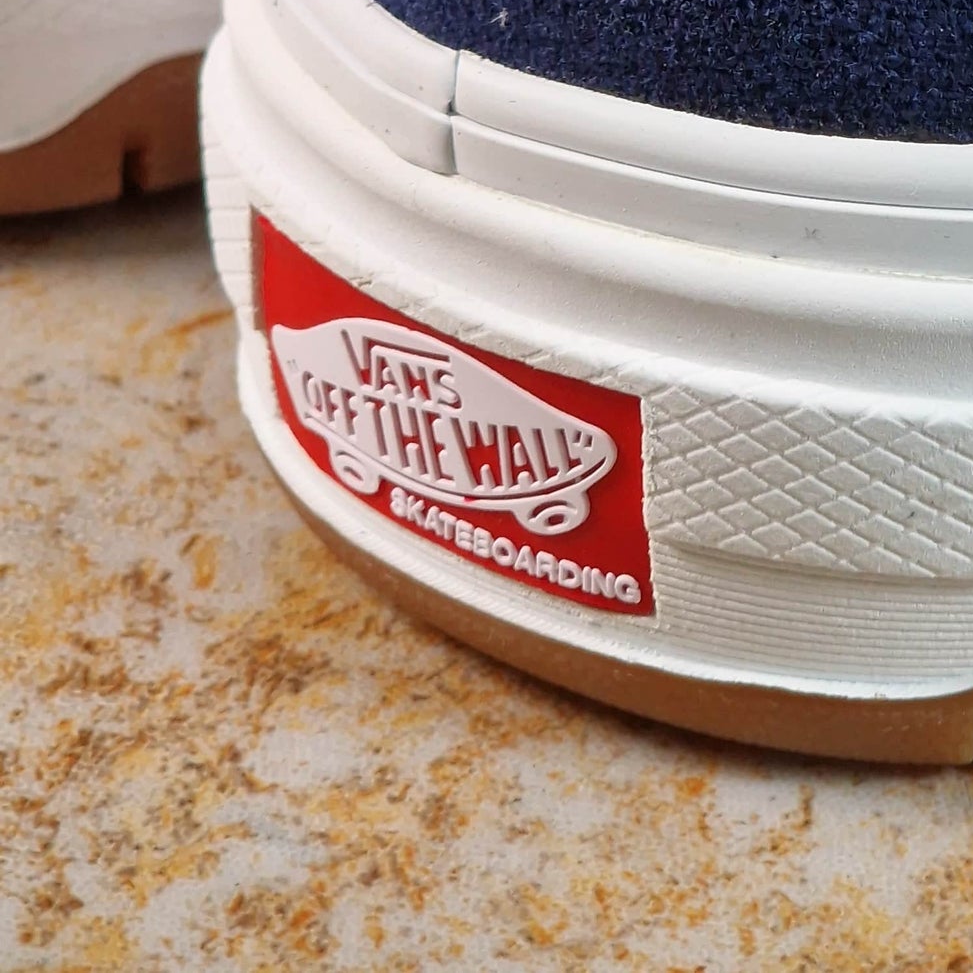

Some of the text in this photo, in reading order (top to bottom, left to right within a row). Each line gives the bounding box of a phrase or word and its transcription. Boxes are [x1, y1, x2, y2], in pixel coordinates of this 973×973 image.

[340, 328, 463, 410] VANS
[363, 394, 456, 484] THE
[389, 486, 642, 604] SKATEBOARDING
